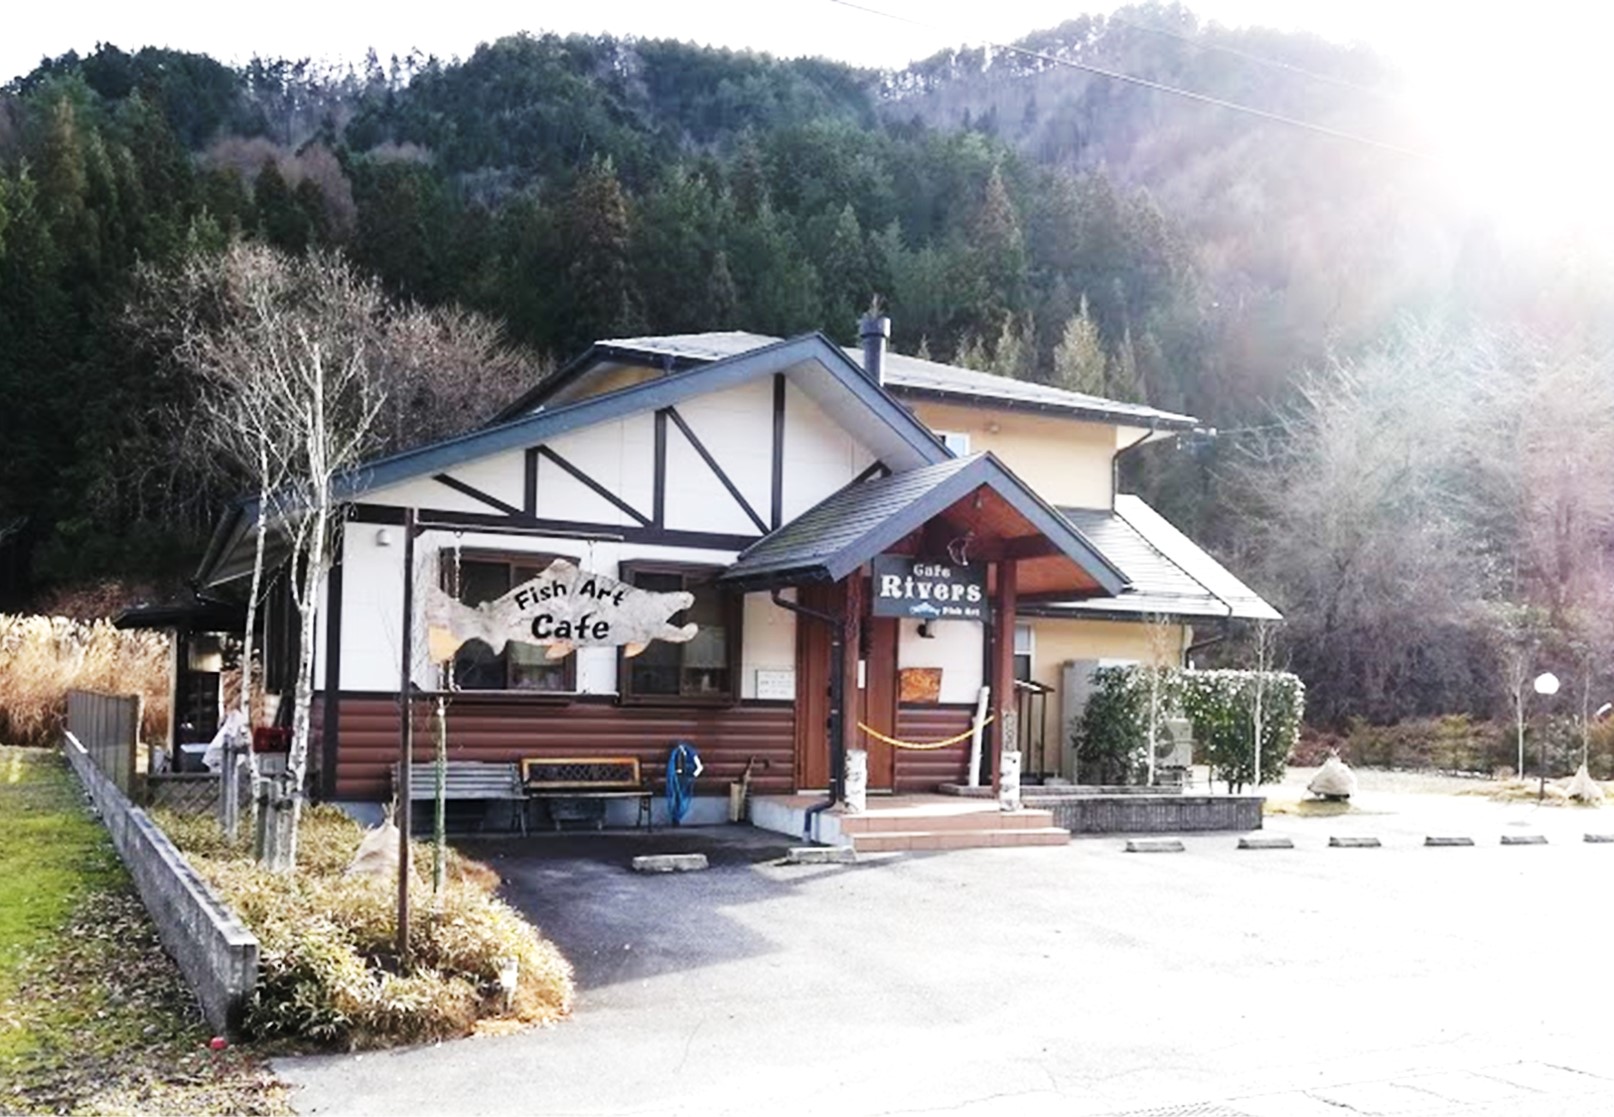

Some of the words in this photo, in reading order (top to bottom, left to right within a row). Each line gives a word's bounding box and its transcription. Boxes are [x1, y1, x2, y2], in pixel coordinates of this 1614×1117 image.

[913, 563, 951, 578] Cafe
[514, 580, 567, 610] Fish
[580, 579, 624, 607] Art
[880, 574, 982, 602] Rivers
[531, 611, 609, 640] Cafe
